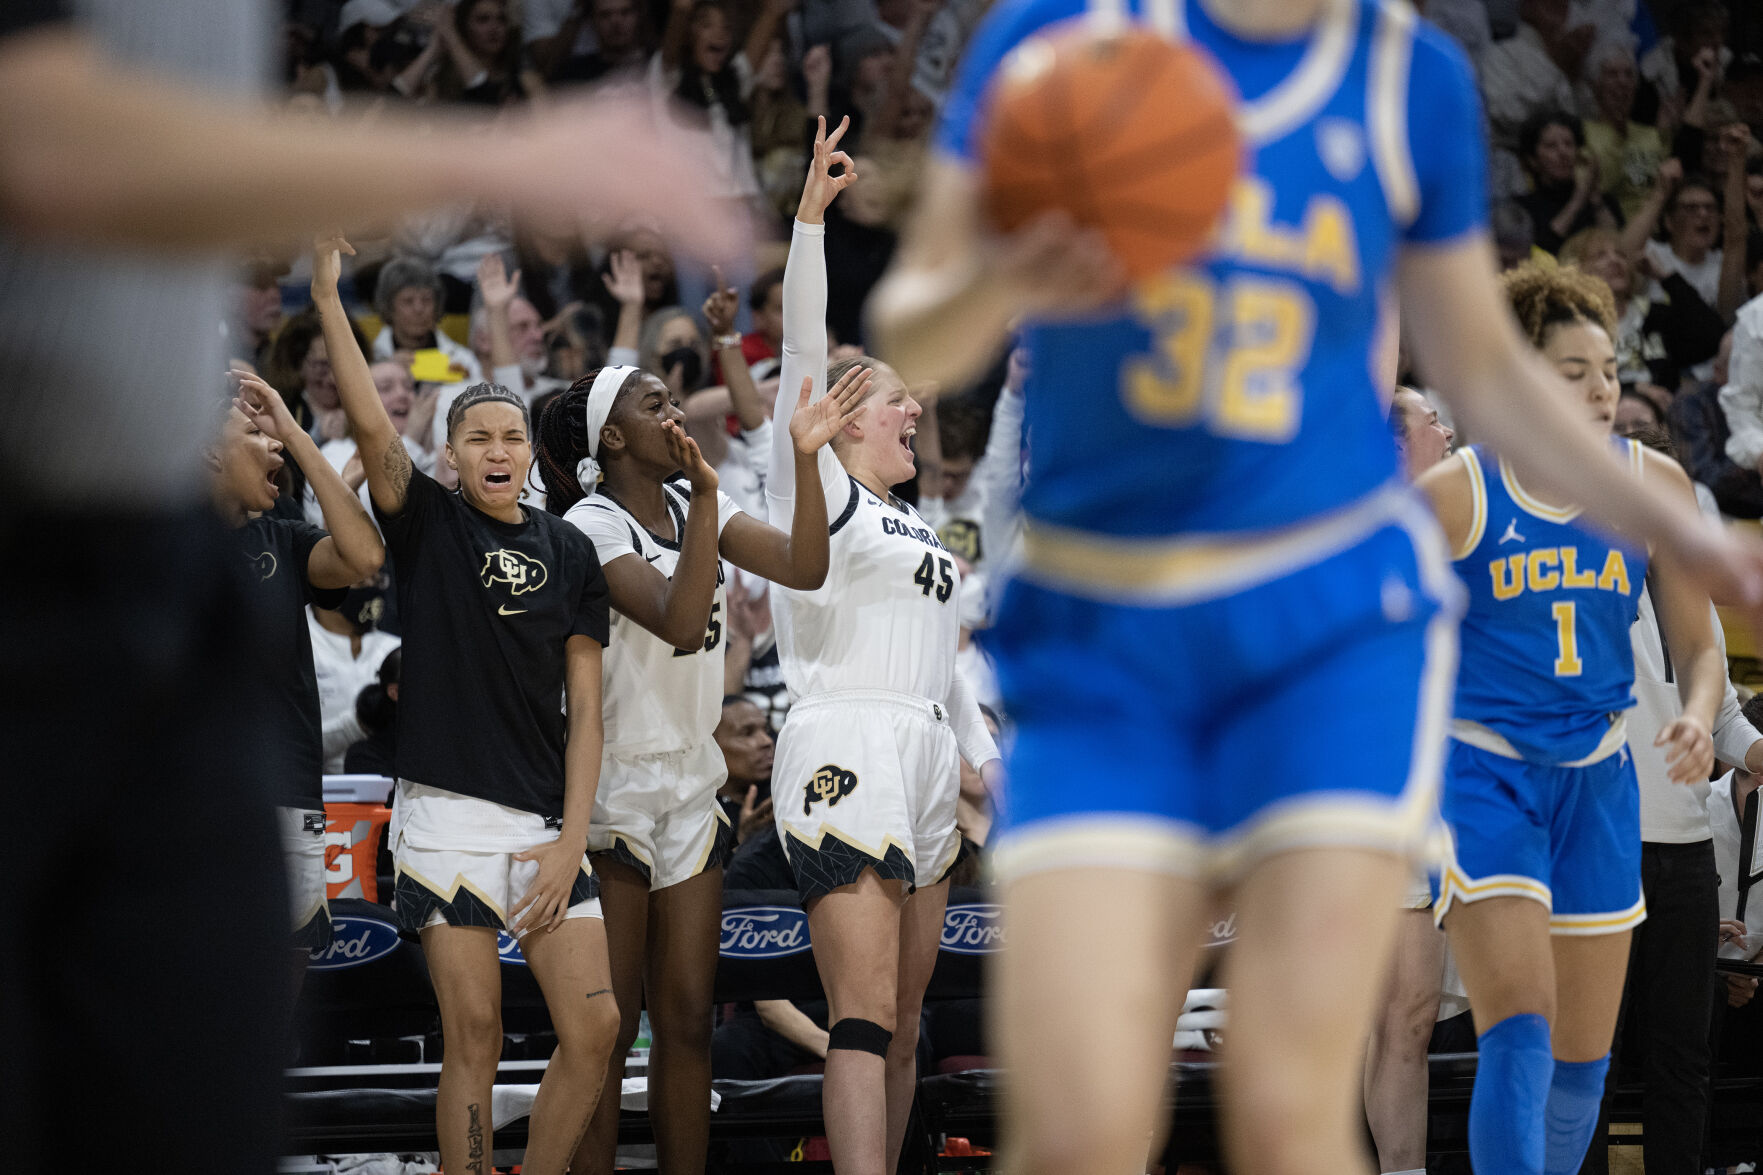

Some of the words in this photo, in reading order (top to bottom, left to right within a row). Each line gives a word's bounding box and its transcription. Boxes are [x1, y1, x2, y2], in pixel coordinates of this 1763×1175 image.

[1206, 175, 1362, 297] LA
[1117, 266, 1317, 445] 32
[499, 548, 527, 584] CU
[913, 551, 954, 606] 45
[1490, 546, 1631, 601] UCLA
[1552, 601, 1582, 677] 1
[813, 770, 841, 799] CU
[309, 923, 371, 960] rd
[720, 913, 804, 949] Ford
